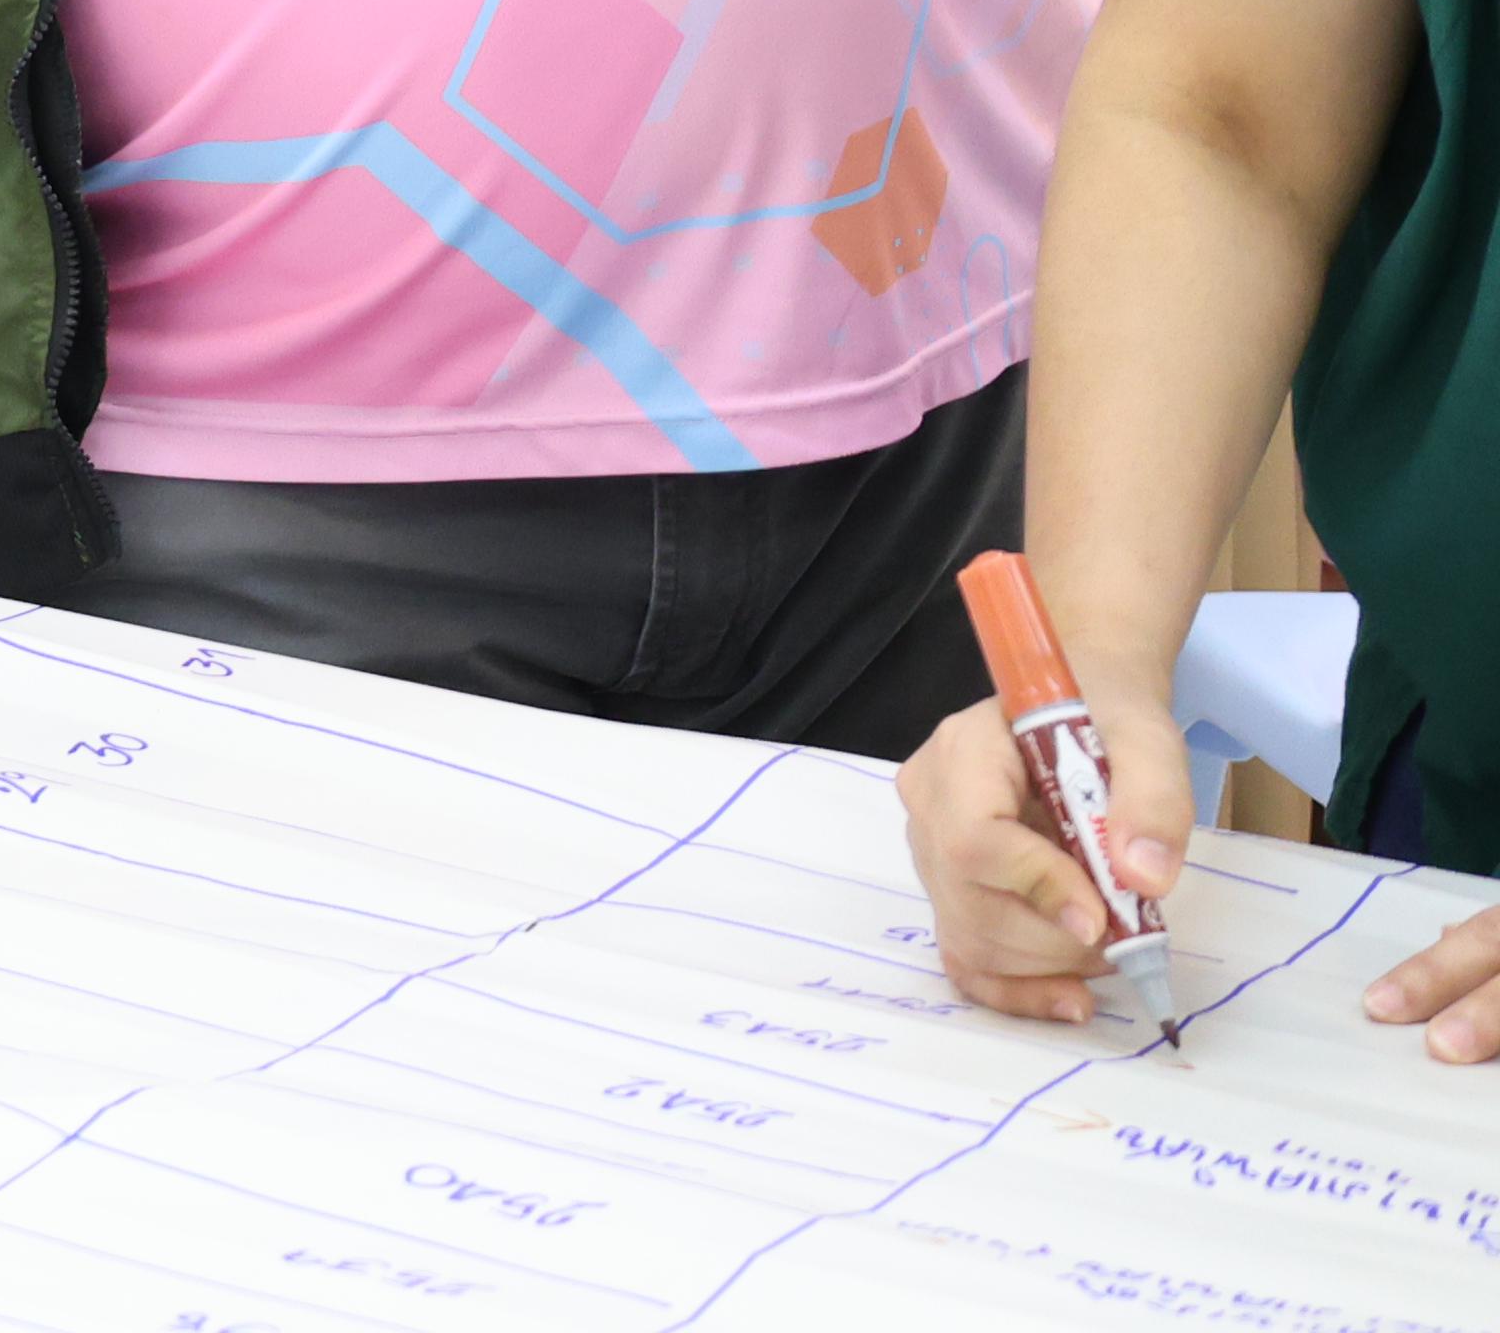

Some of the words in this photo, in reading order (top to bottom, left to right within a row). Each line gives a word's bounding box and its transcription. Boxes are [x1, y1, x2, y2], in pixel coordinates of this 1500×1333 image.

[181, 646, 255, 679] 31
[69, 729, 150, 769] 30
[602, 1074, 796, 1131] 2542
[403, 1162, 610, 1230] 2540
